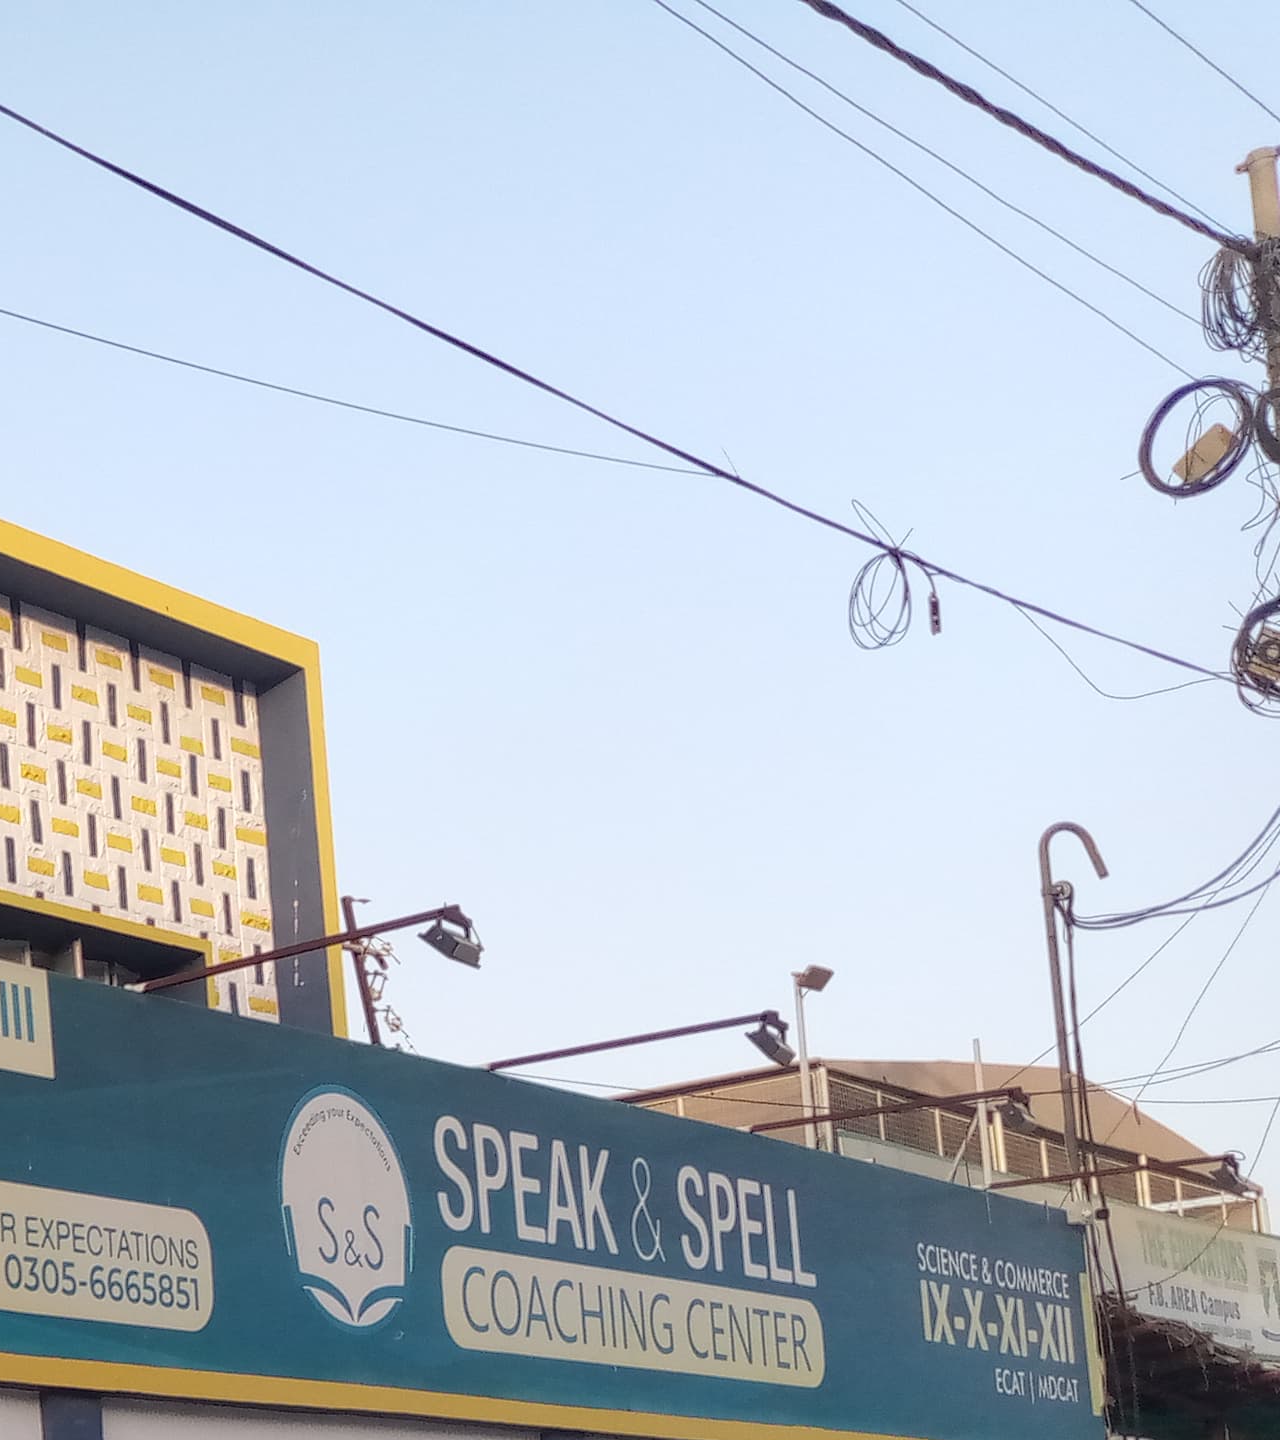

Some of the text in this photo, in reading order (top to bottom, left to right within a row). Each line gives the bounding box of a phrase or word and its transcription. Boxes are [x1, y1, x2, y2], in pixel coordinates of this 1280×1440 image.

[434, 1115, 817, 1287] SPEAK & SPELL
[25, 1216, 200, 1270] EXPECTATIONS
[317, 1196, 384, 1271] S&S
[5, 1253, 201, 1312] 0305-6665851
[917, 1242, 1070, 1299] SCIENCE & COMMERCE
[462, 1266, 814, 1372] COACHING CENTER
[995, 1368, 1025, 1396] ECAT
[1038, 1375, 1079, 1403] MDCAT
